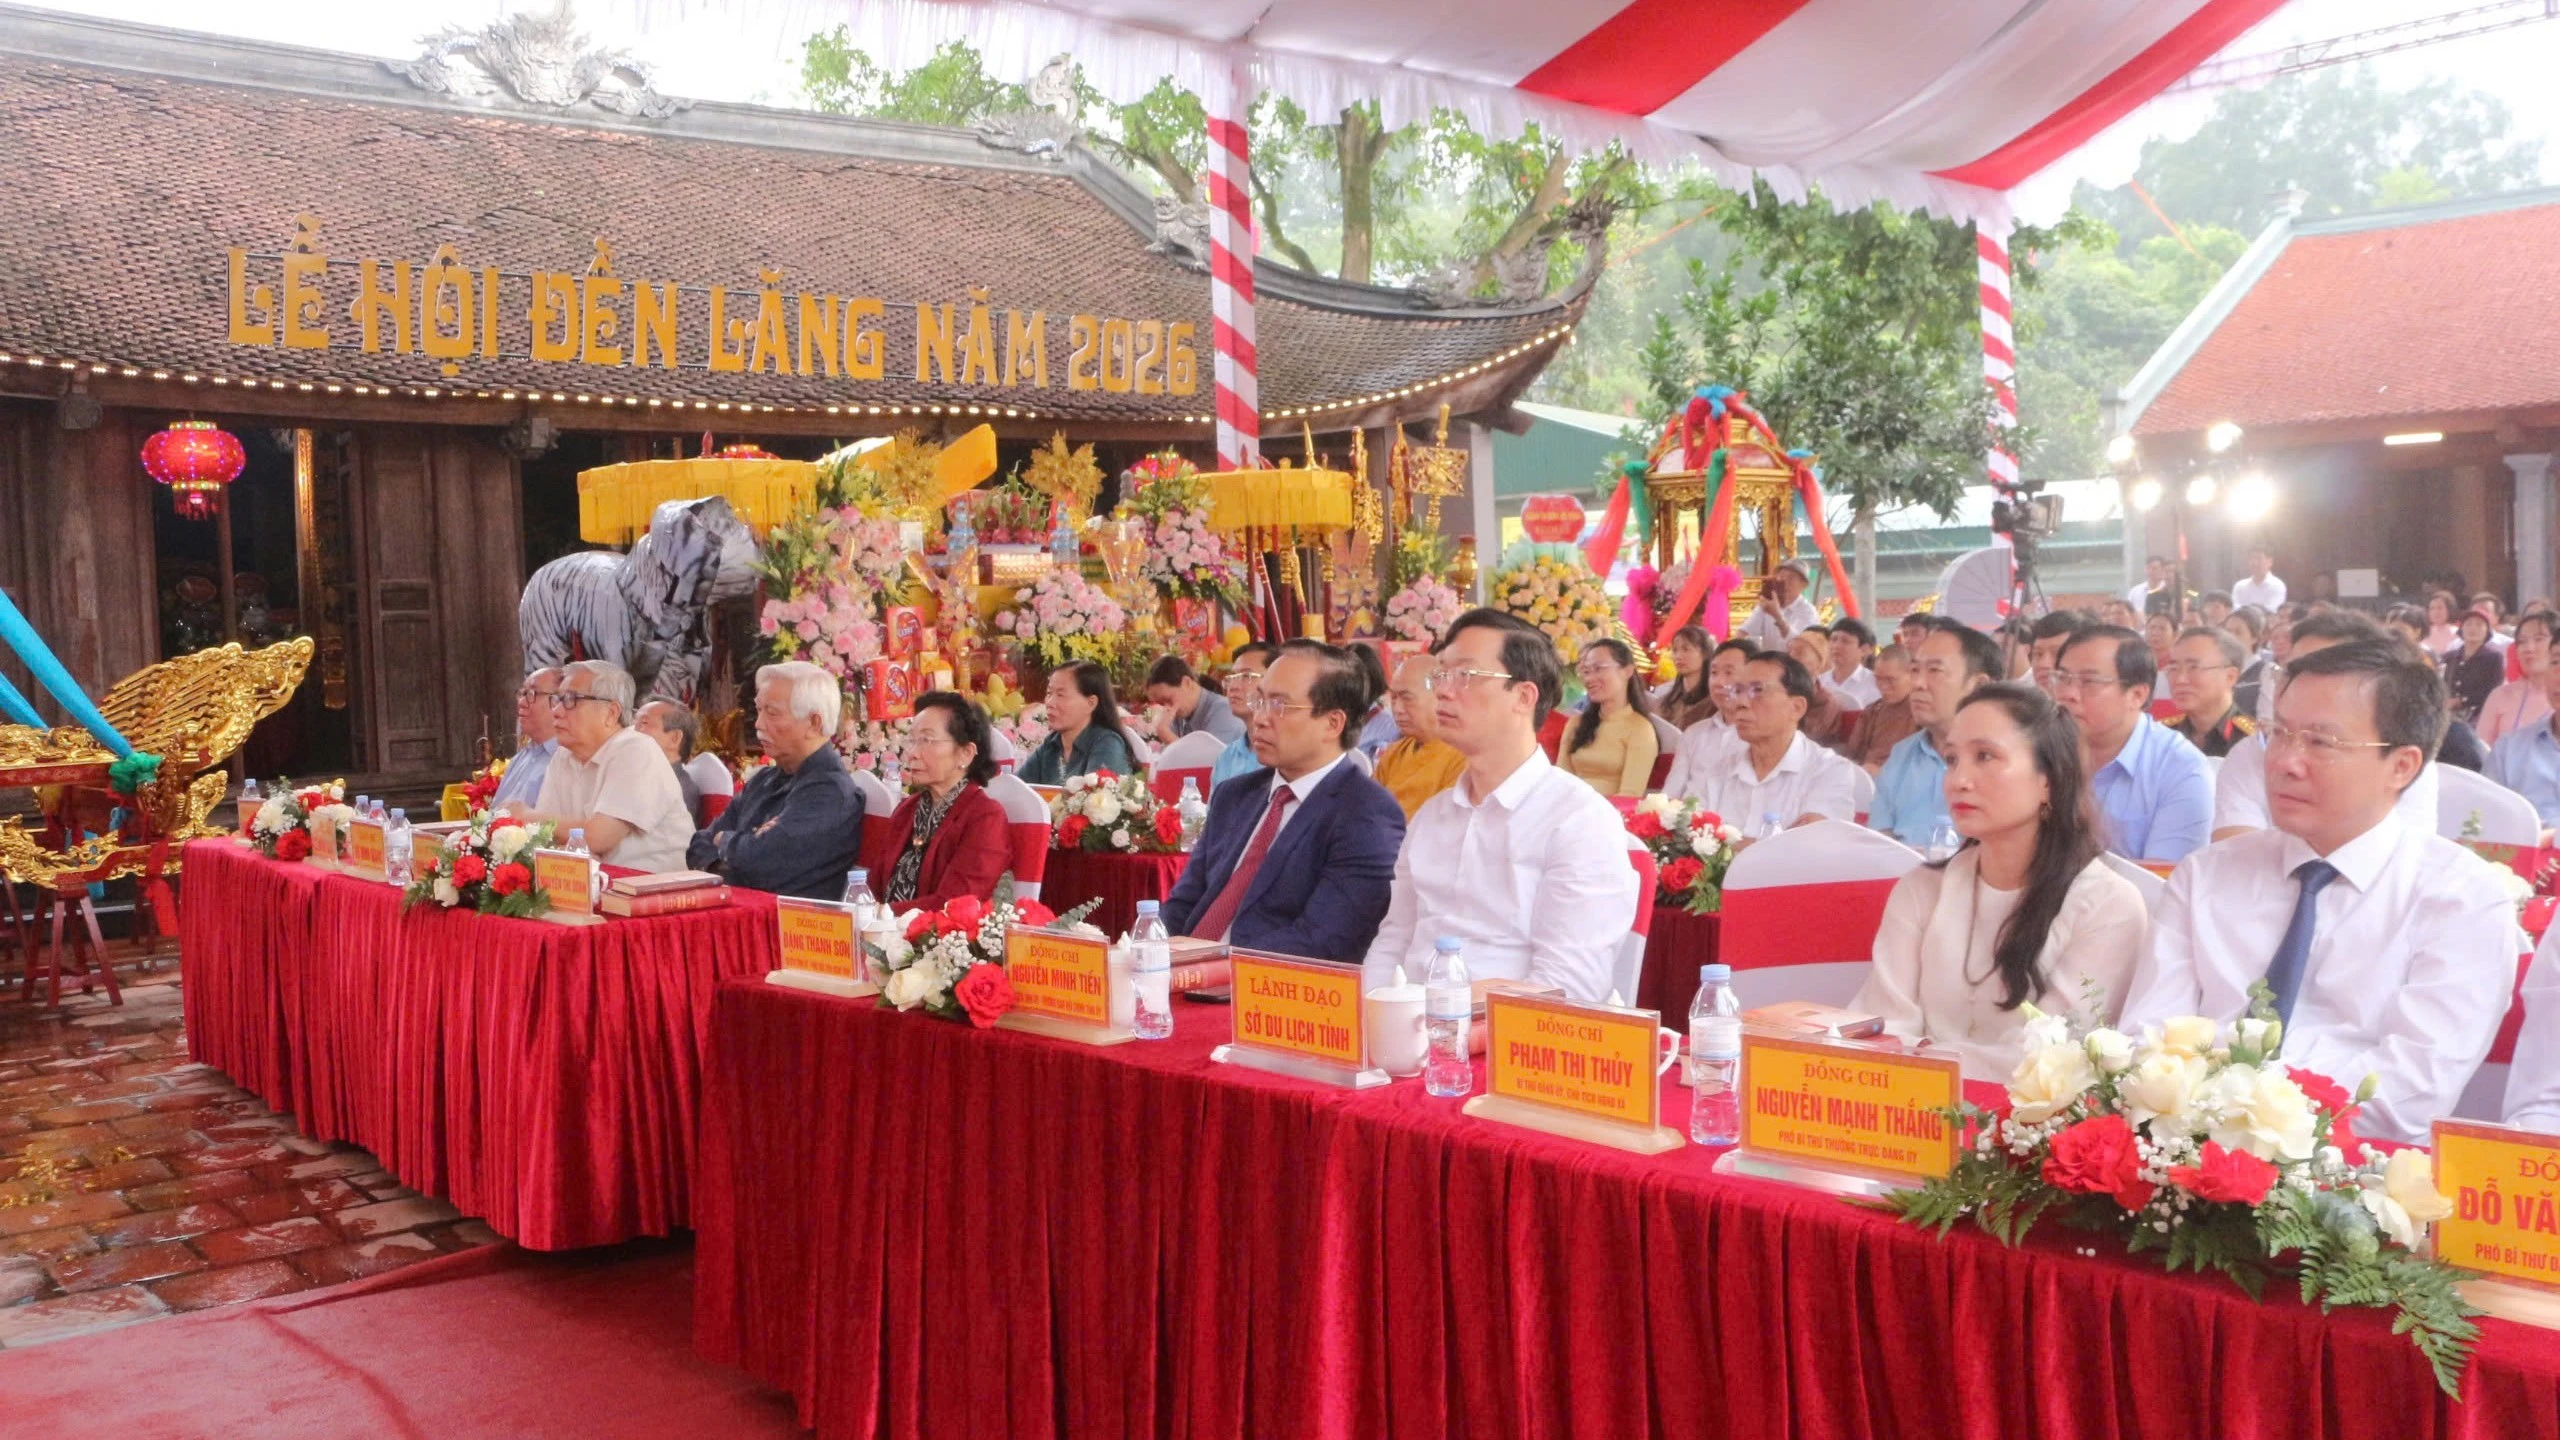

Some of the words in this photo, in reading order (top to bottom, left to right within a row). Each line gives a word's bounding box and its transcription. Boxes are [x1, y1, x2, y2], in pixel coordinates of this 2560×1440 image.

[350, 243, 498, 376] HỘI
[527, 236, 677, 369] ĐỀN
[708, 267, 885, 380] LĂNG
[916, 285, 1048, 388] NĂM
[1068, 314, 1198, 395] 2026
[1012, 960, 1049, 986] NGUYỄN
[1051, 968, 1077, 991] MINH
[1079, 969, 1101, 996] TIẾN
[1250, 976, 1298, 1001] LÃNH
[1303, 985, 1342, 1010] ĐẠO
[1265, 1014, 1282, 1038] DU
[1286, 1018, 1315, 1046] LỊCH
[1318, 1018, 1350, 1052] TỈNH
[1510, 1041, 1556, 1076] PHẠM
[1561, 1050, 1585, 1085] THỊ
[1591, 1051, 1632, 1088] THỦY
[1804, 1059, 1853, 1084] ĐỒNG
[1858, 1069, 1889, 1089] CHÍ
[1756, 1083, 1823, 1122] NGUYỄN
[1827, 1097, 1879, 1135] MẠNH
[1884, 1097, 1942, 1141] THẮNG
[2459, 1177, 2502, 1225] ĐỖ
[2475, 1243, 2500, 1262] PHÓ
[2505, 1246, 2518, 1265] BÍ
[2522, 1251, 2548, 1270] THƯ
